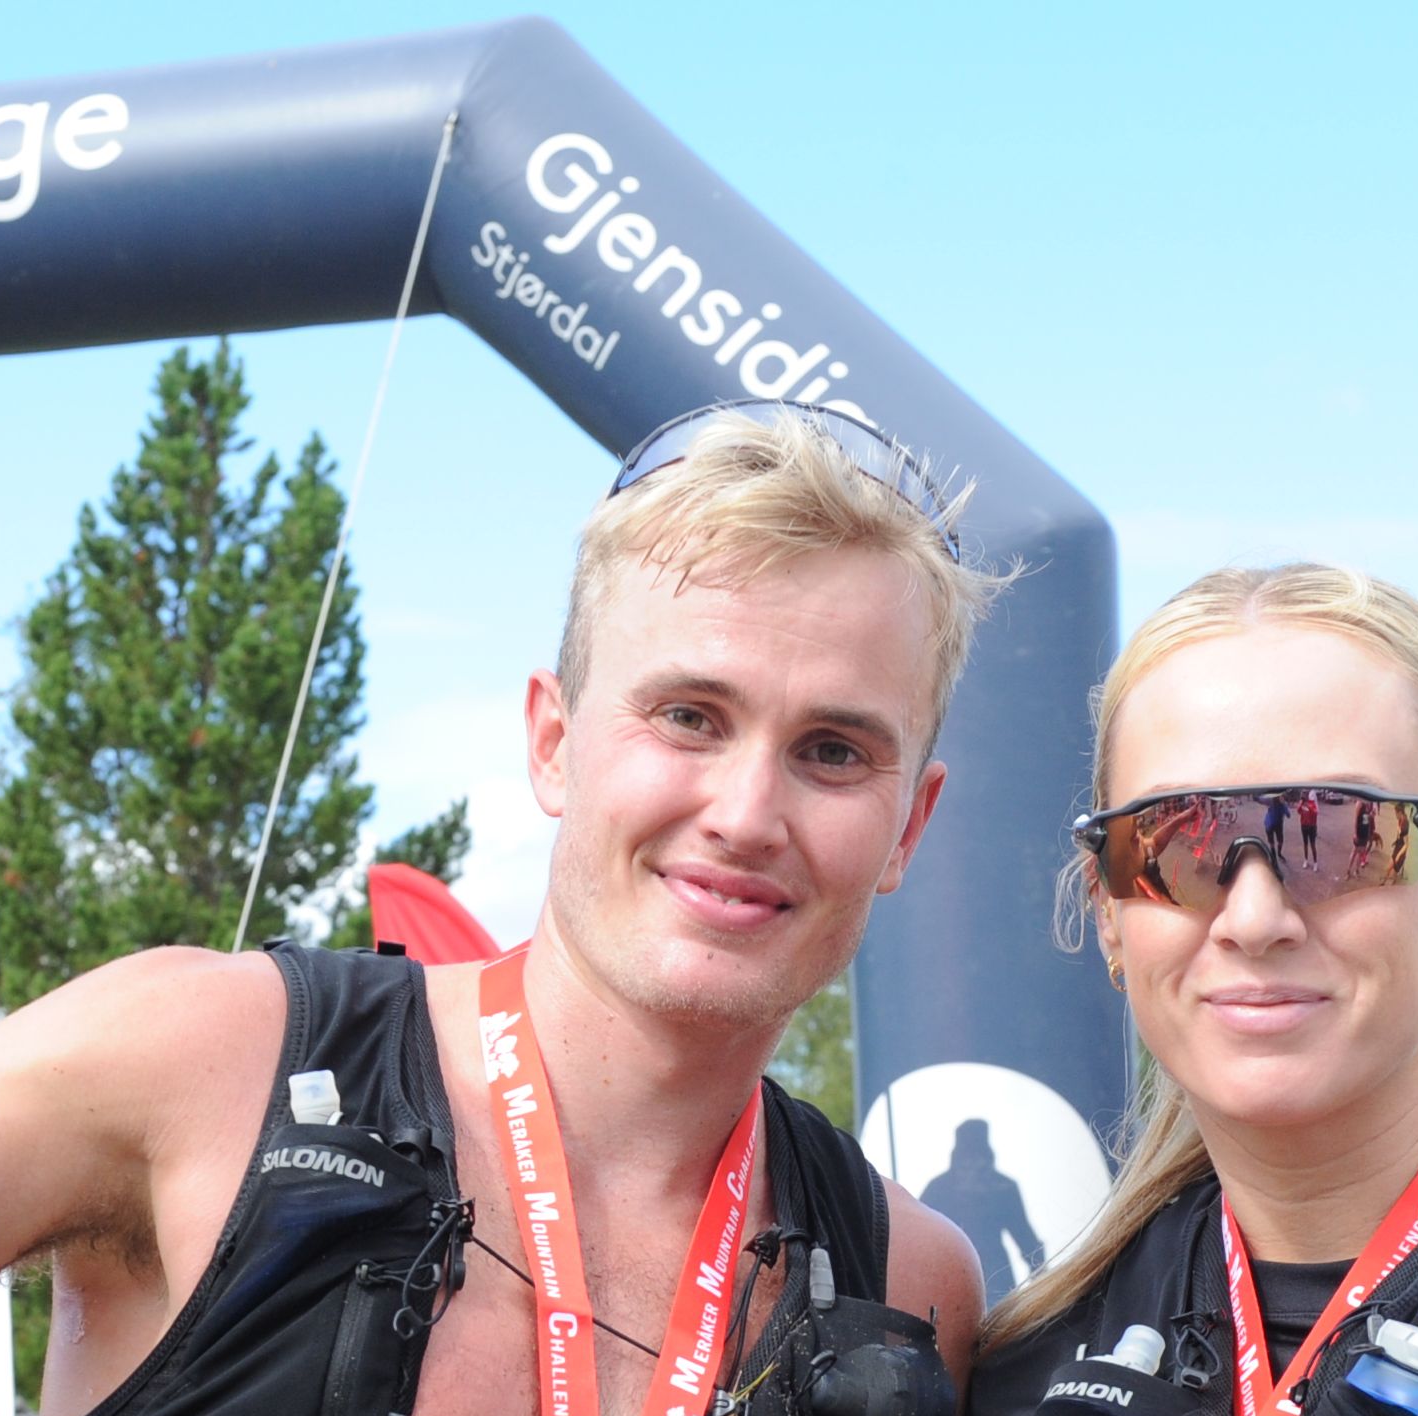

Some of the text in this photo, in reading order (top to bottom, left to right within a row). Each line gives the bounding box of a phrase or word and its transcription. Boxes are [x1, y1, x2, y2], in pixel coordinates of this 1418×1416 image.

[471, 221, 620, 371] Stjørdal
[526, 132, 879, 429] Gjensidi
[261, 1148, 385, 1188] SALOMON
[502, 1083, 538, 1184] MERÅKER
[524, 1191, 561, 1299] MOUNTAIN
[669, 1302, 719, 1396] MERÅKER
[695, 1206, 741, 1299] MOUNTAIN
[1046, 1381, 1134, 1408] OMON
